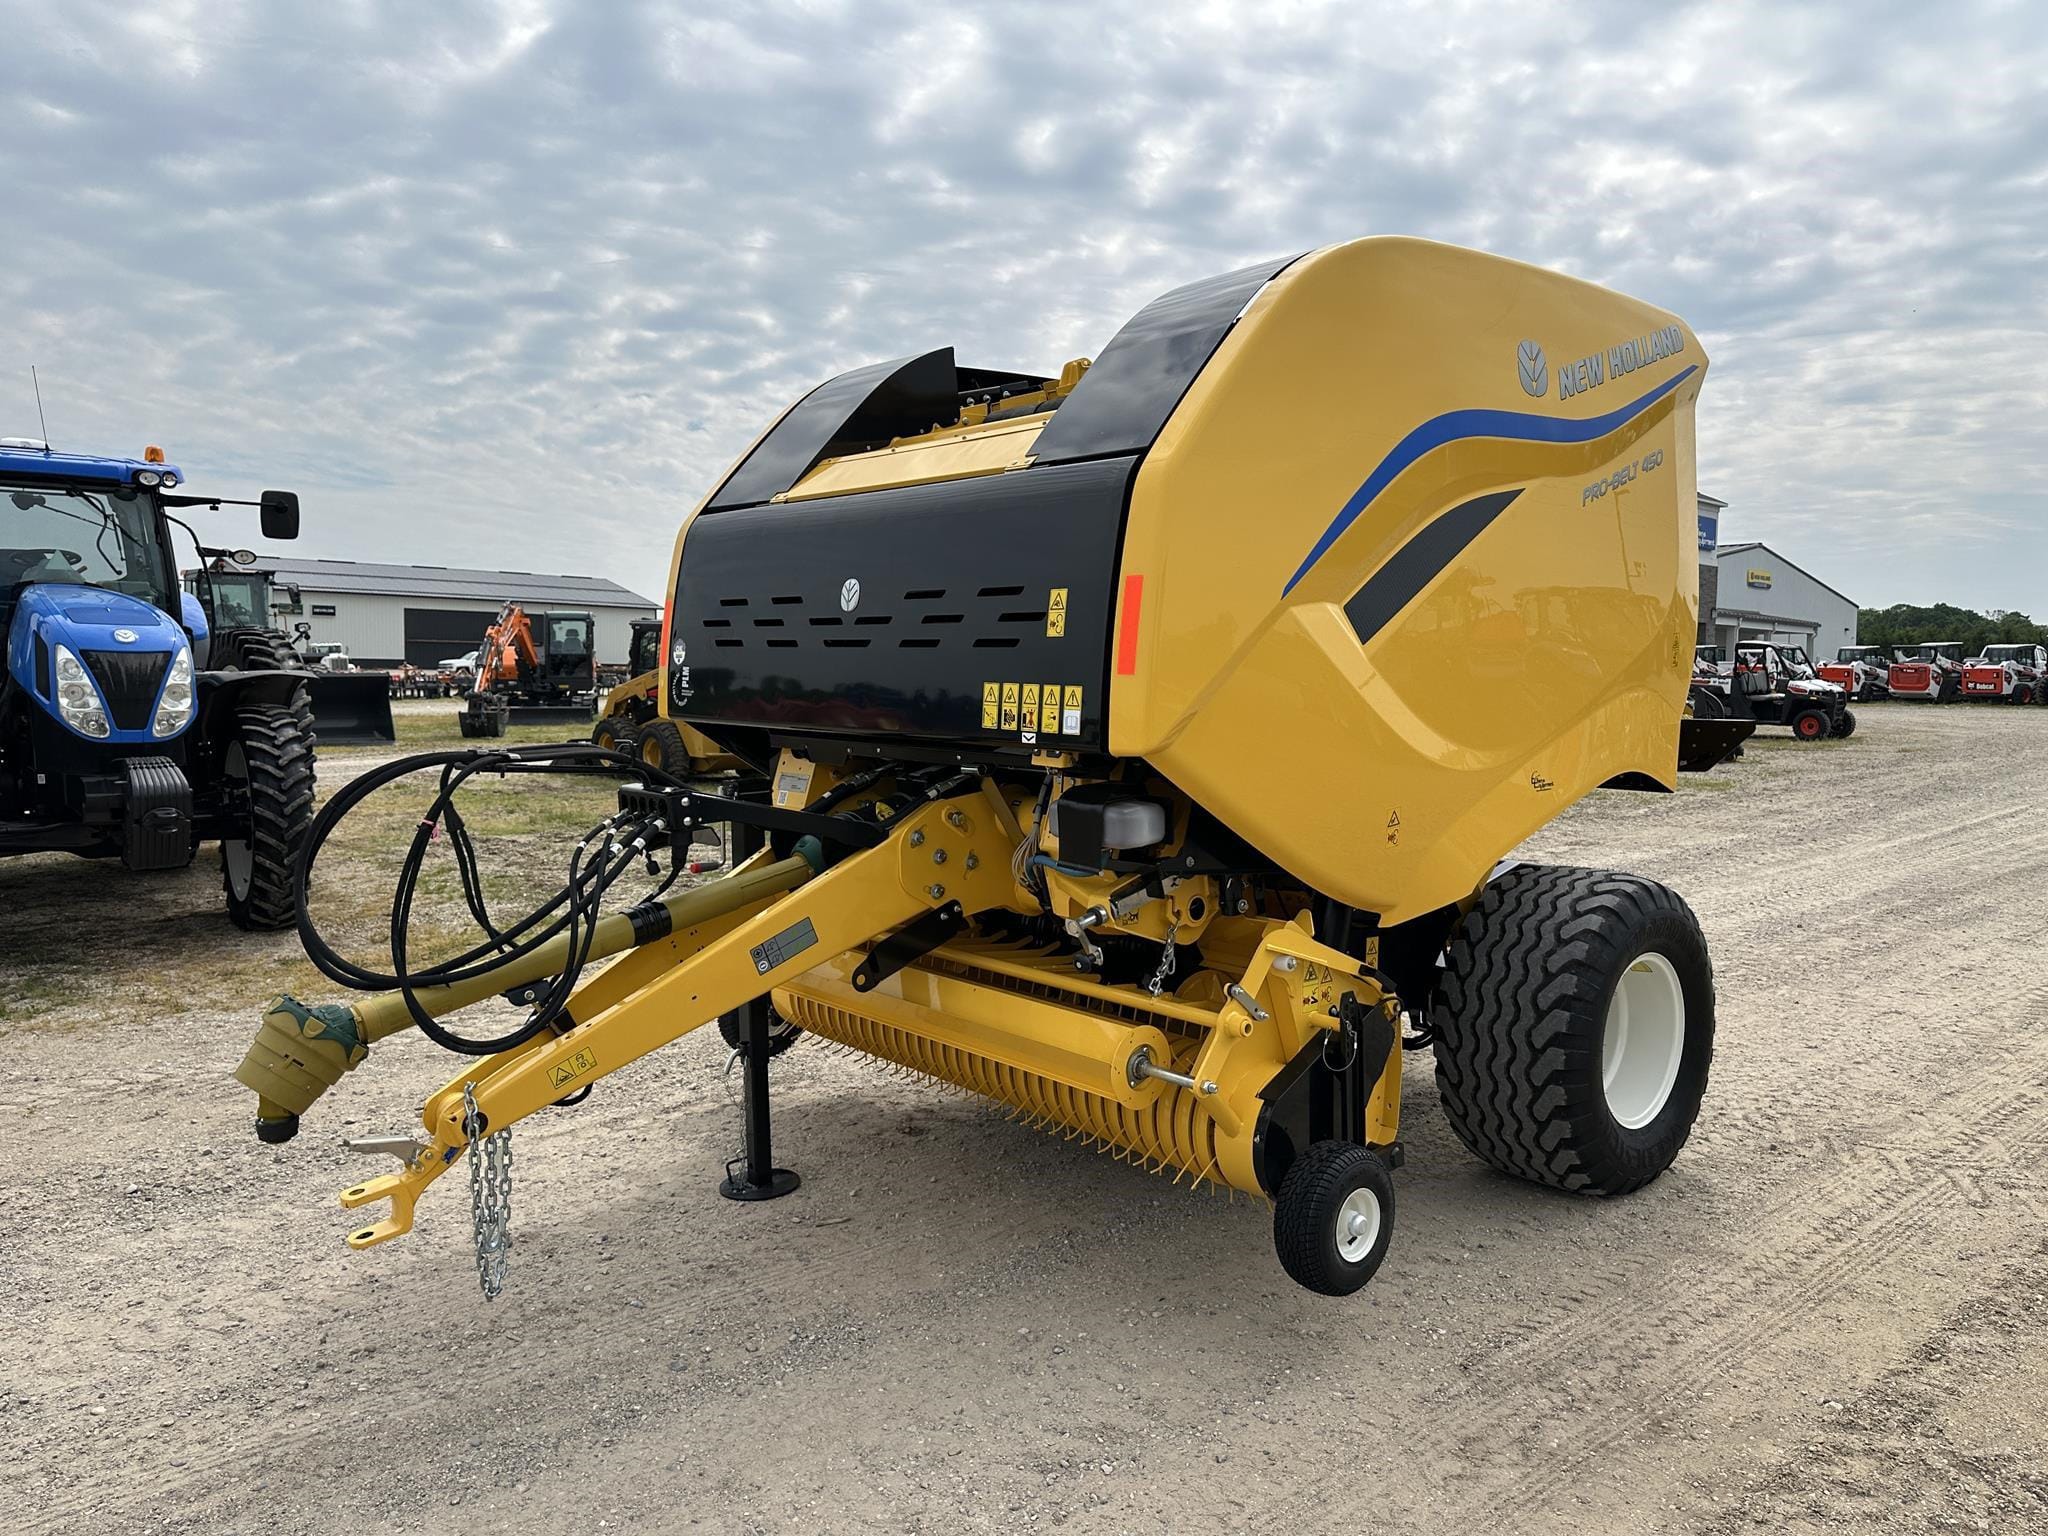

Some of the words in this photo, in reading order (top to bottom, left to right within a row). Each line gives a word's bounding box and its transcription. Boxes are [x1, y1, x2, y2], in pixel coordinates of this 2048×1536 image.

[1557, 352, 1605, 401] NEW
[1607, 324, 1685, 380] HOLLAND
[1581, 459, 1640, 508] PRO-BELT
[1641, 449, 1664, 473] 450
[681, 666, 690, 688] PLM
